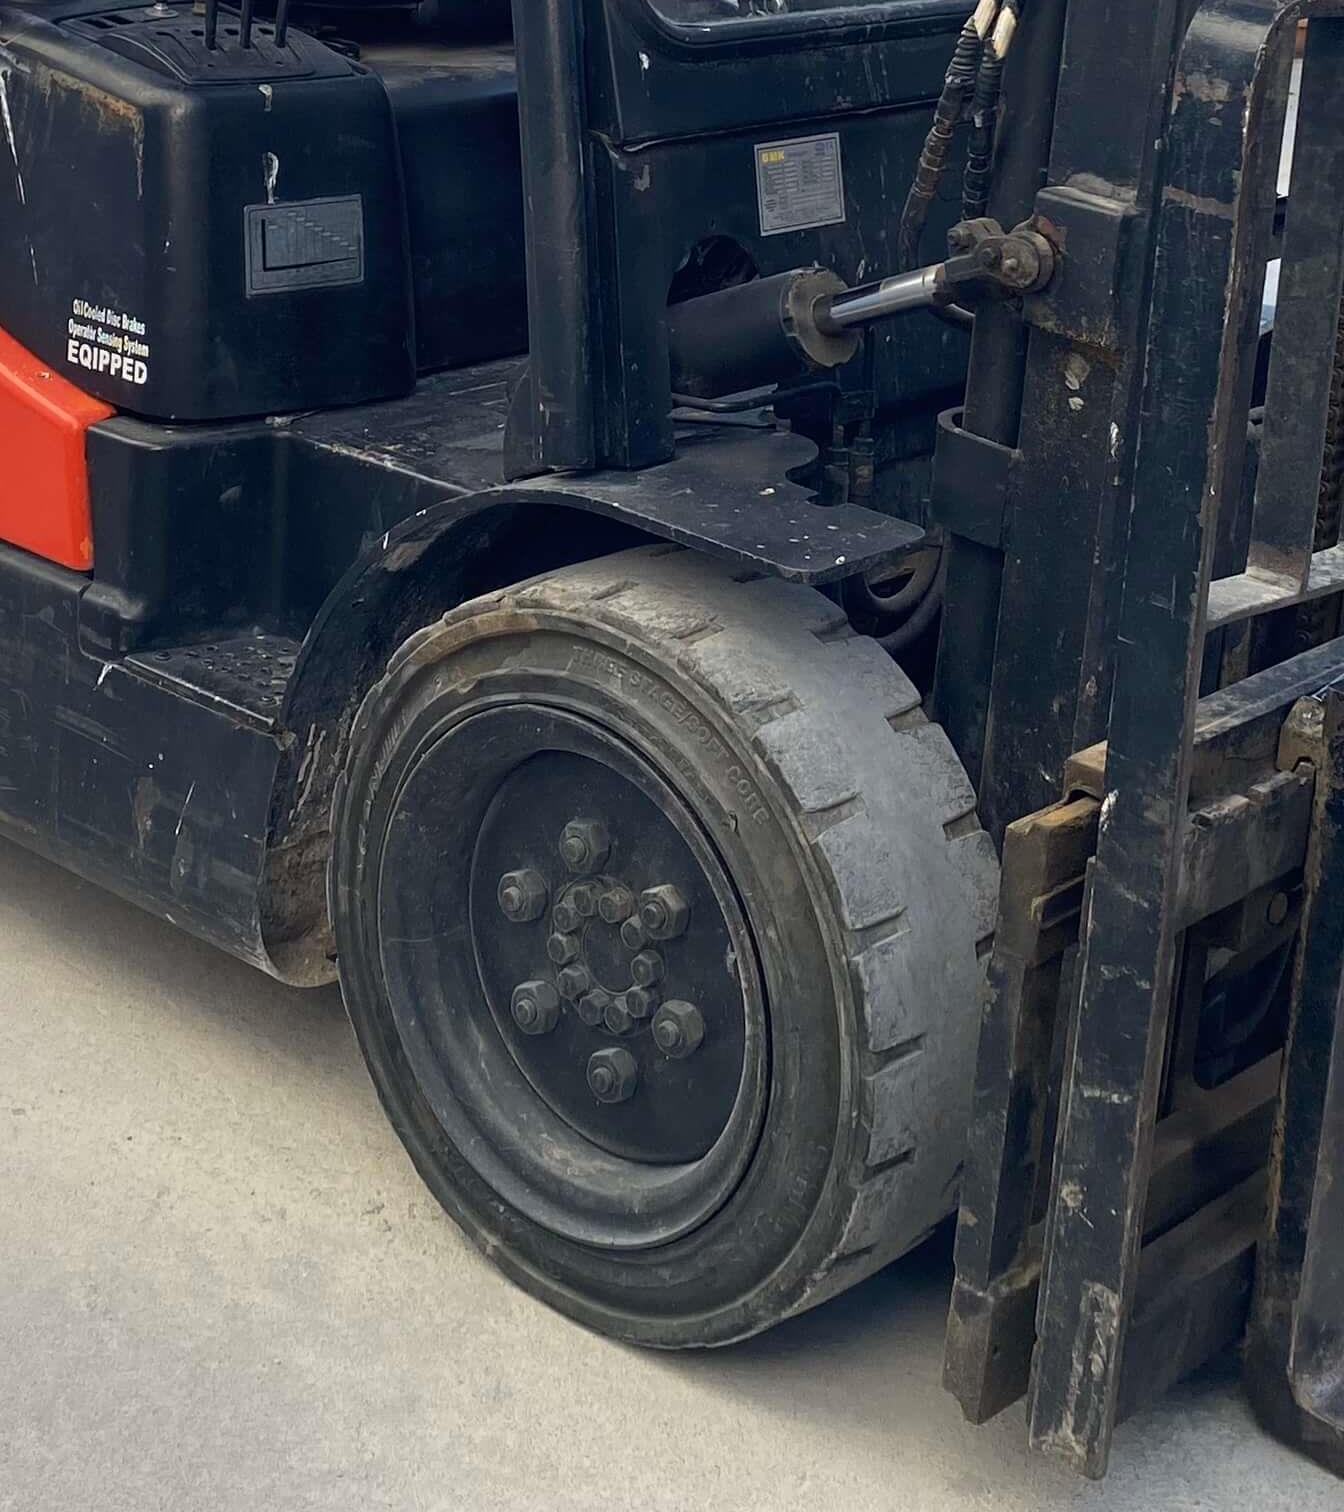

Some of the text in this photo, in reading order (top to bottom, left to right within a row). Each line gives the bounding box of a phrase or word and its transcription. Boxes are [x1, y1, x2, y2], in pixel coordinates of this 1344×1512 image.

[73, 299, 145, 336] Oil Cooled Disc Brakes
[68, 318, 149, 357] Operator Sensing System
[67, 339, 148, 384] EQIPPED
